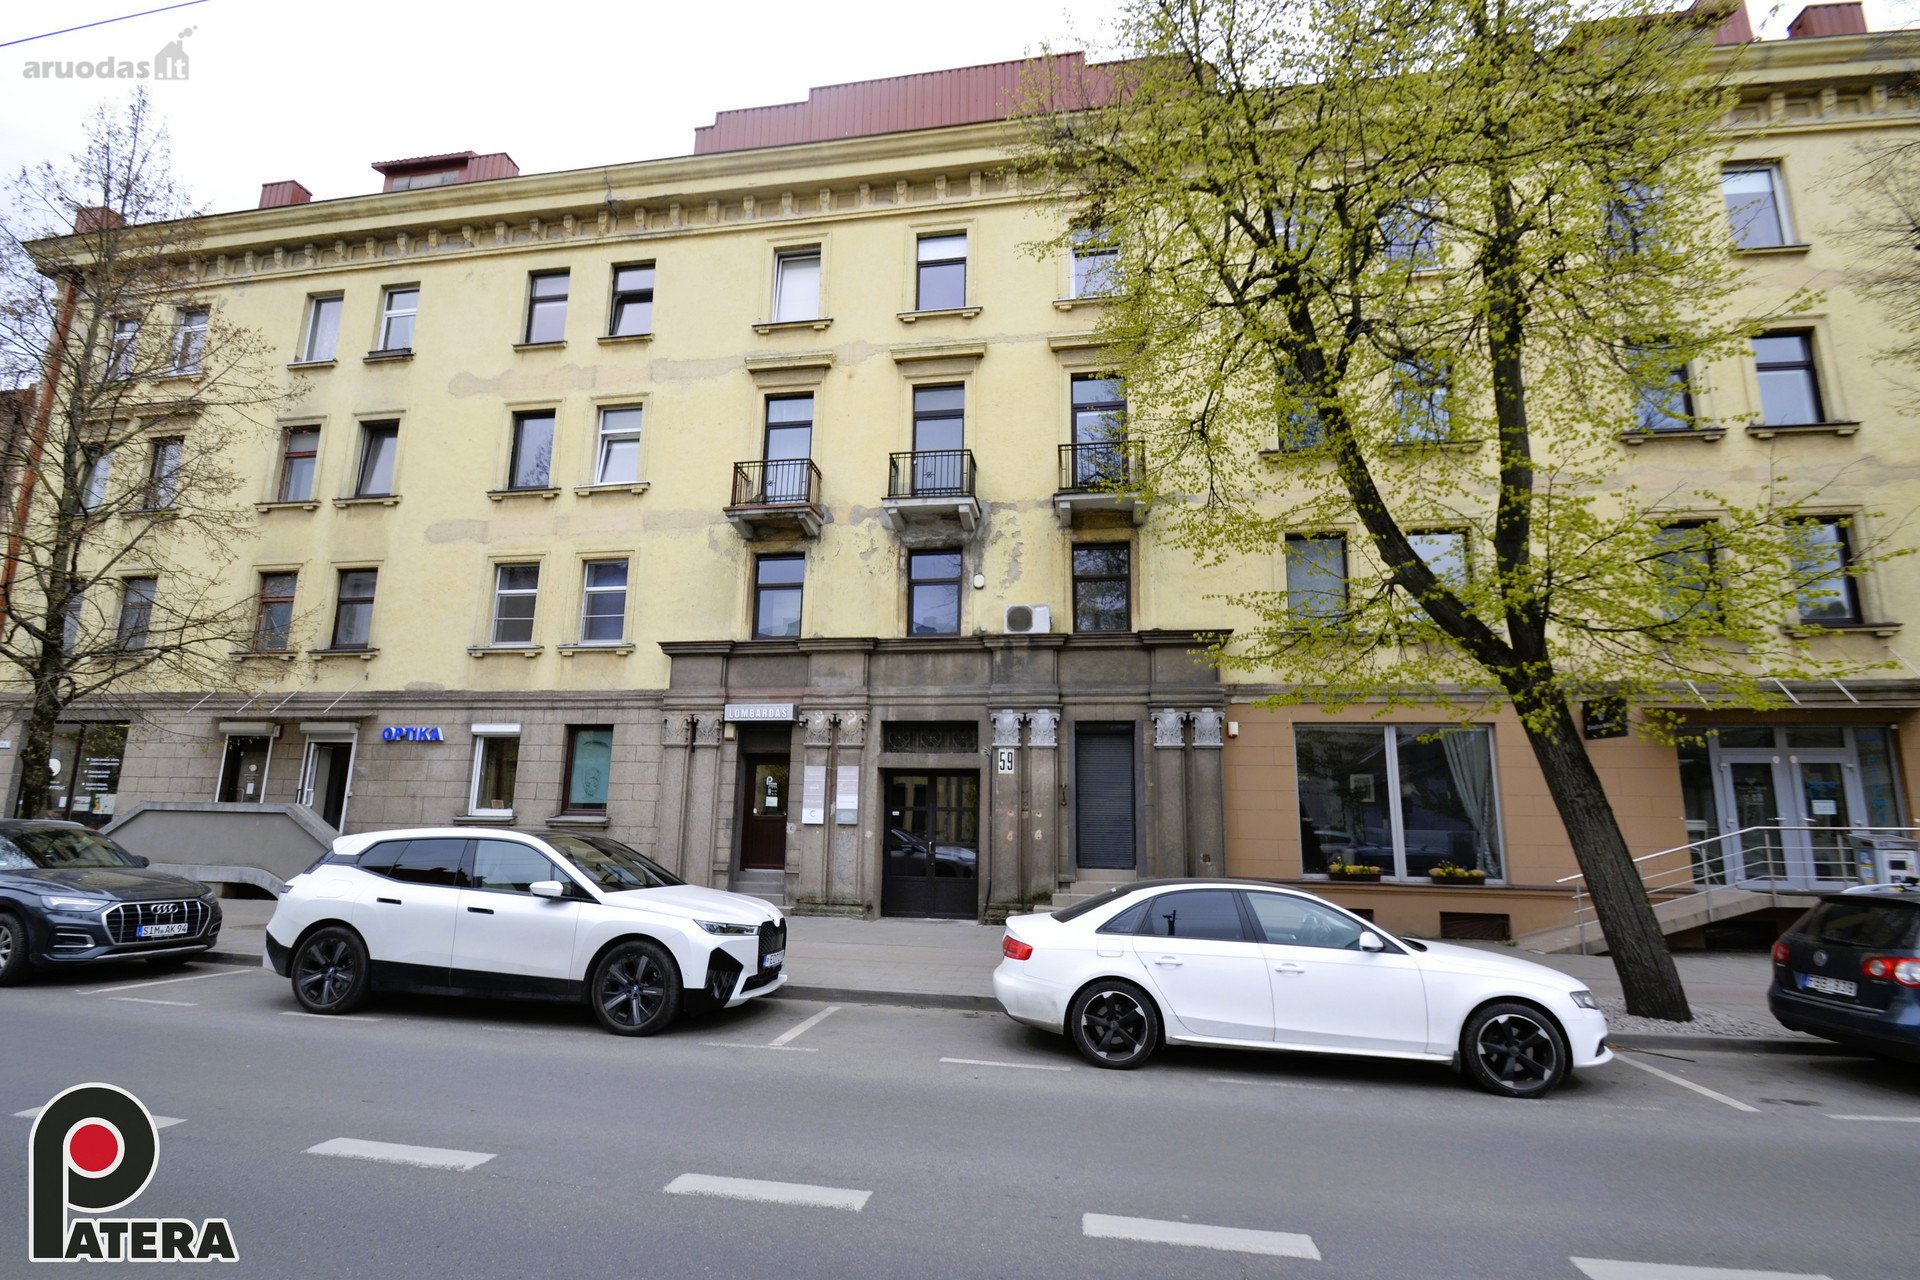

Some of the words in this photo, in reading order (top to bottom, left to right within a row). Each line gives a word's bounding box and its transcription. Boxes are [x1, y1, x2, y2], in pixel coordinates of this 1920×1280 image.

[729, 708, 787, 718] LOMBARDAS
[382, 727, 444, 741] OPTIKA
[1000, 751, 1013, 770] 59
[143, 926, 160, 935] SIM
[165, 925, 176, 933] AK
[177, 924, 187, 933] 94
